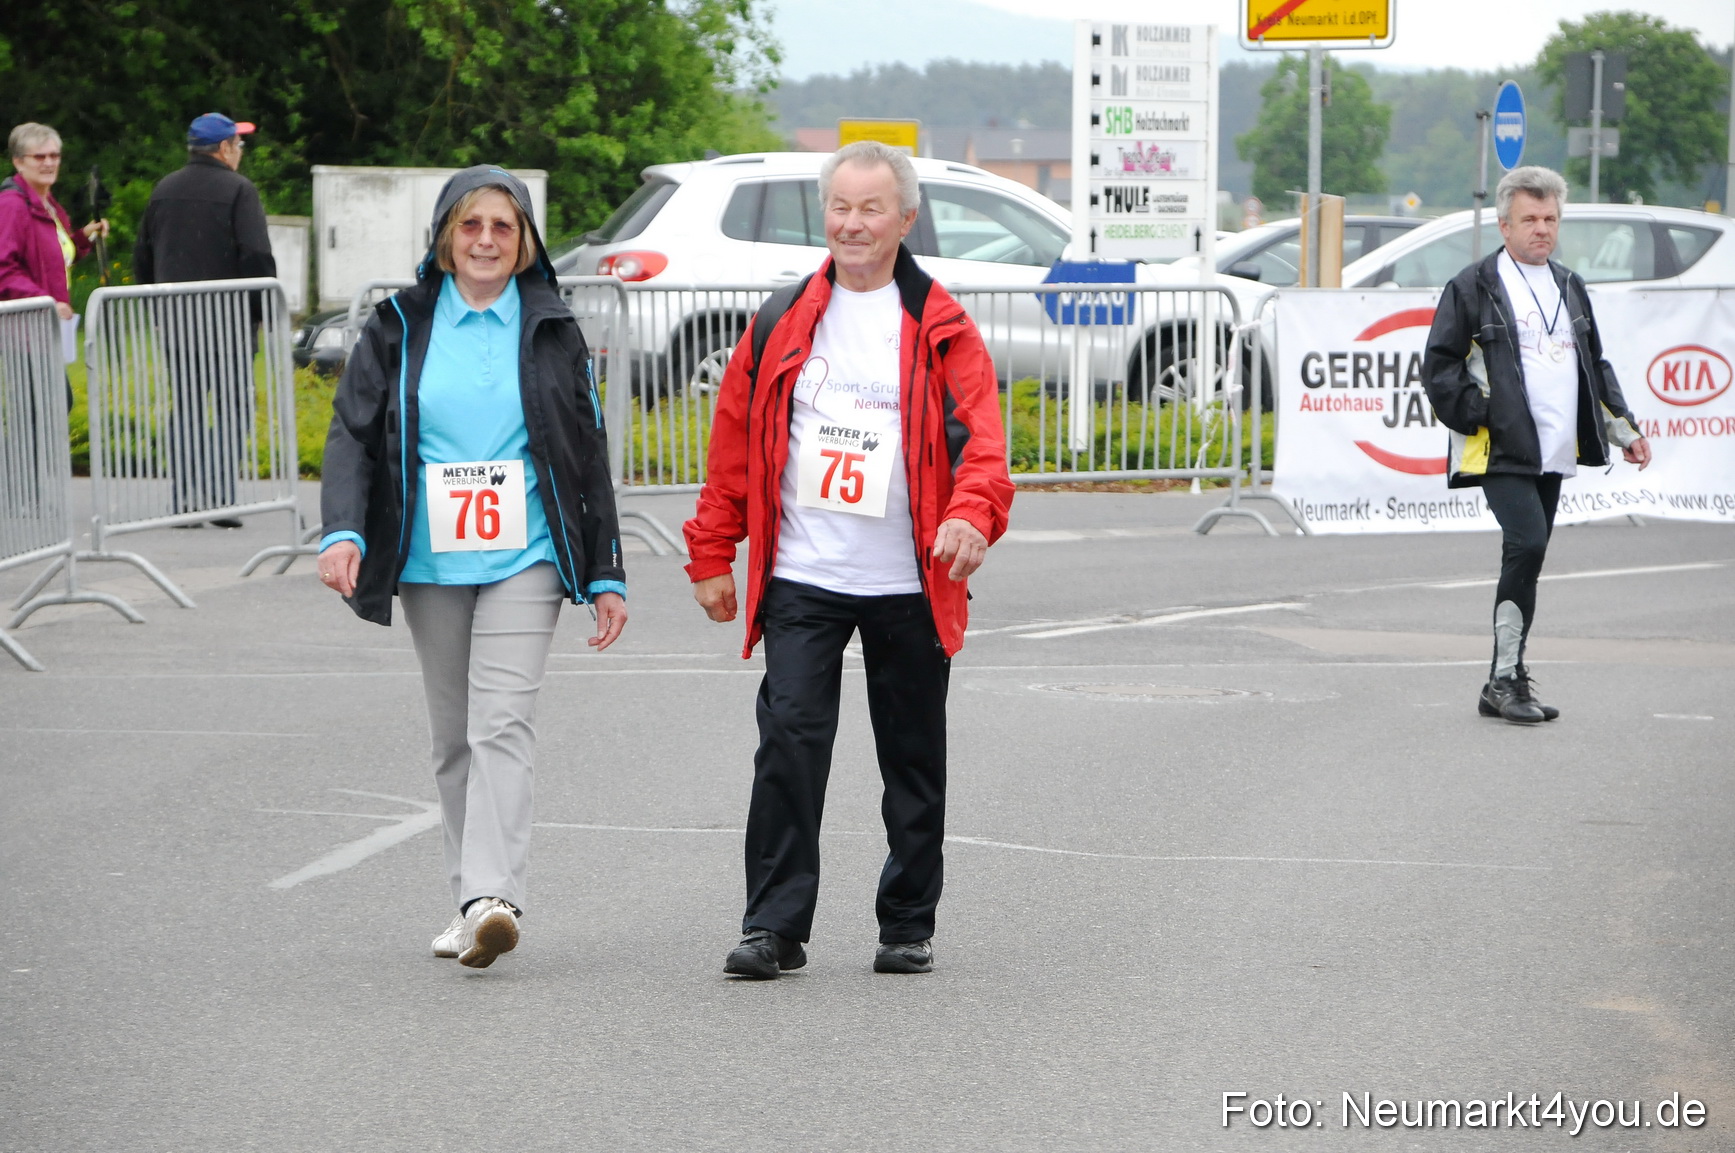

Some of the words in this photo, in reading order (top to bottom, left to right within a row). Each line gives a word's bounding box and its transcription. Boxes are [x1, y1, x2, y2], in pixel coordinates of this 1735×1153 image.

[1287, 12, 1338, 26] Neumarkt
[1136, 25, 1190, 43] HOLZAMMER
[1136, 64, 1190, 82] HOLZAMMER
[1105, 106, 1133, 136] SHB
[1135, 111, 1189, 131] Holzfachmarkt
[1104, 186, 1149, 213] THULE
[1104, 224, 1188, 238] HEIDELBERGCEMENT
[1301, 351, 1425, 389] GERHA
[1663, 359, 1716, 391] KIA
[795, 379, 812, 389] erz
[826, 379, 860, 393] Sport
[871, 381, 900, 397] Grup
[855, 399, 901, 410] Neuma
[1300, 393, 1384, 412] Autohaus
[819, 425, 860, 440] MEYER
[818, 436, 860, 448] WERBUNG
[443, 467, 486, 478] MEYER
[443, 476, 487, 486] WERBUNG
[820, 449, 865, 504] 75
[1294, 498, 1370, 522] Neumarkt
[1386, 495, 1481, 525] Sengenthal
[1557, 492, 1611, 514] 81/26
[1667, 493, 1735, 516] www.ge
[449, 488, 500, 540] 76
